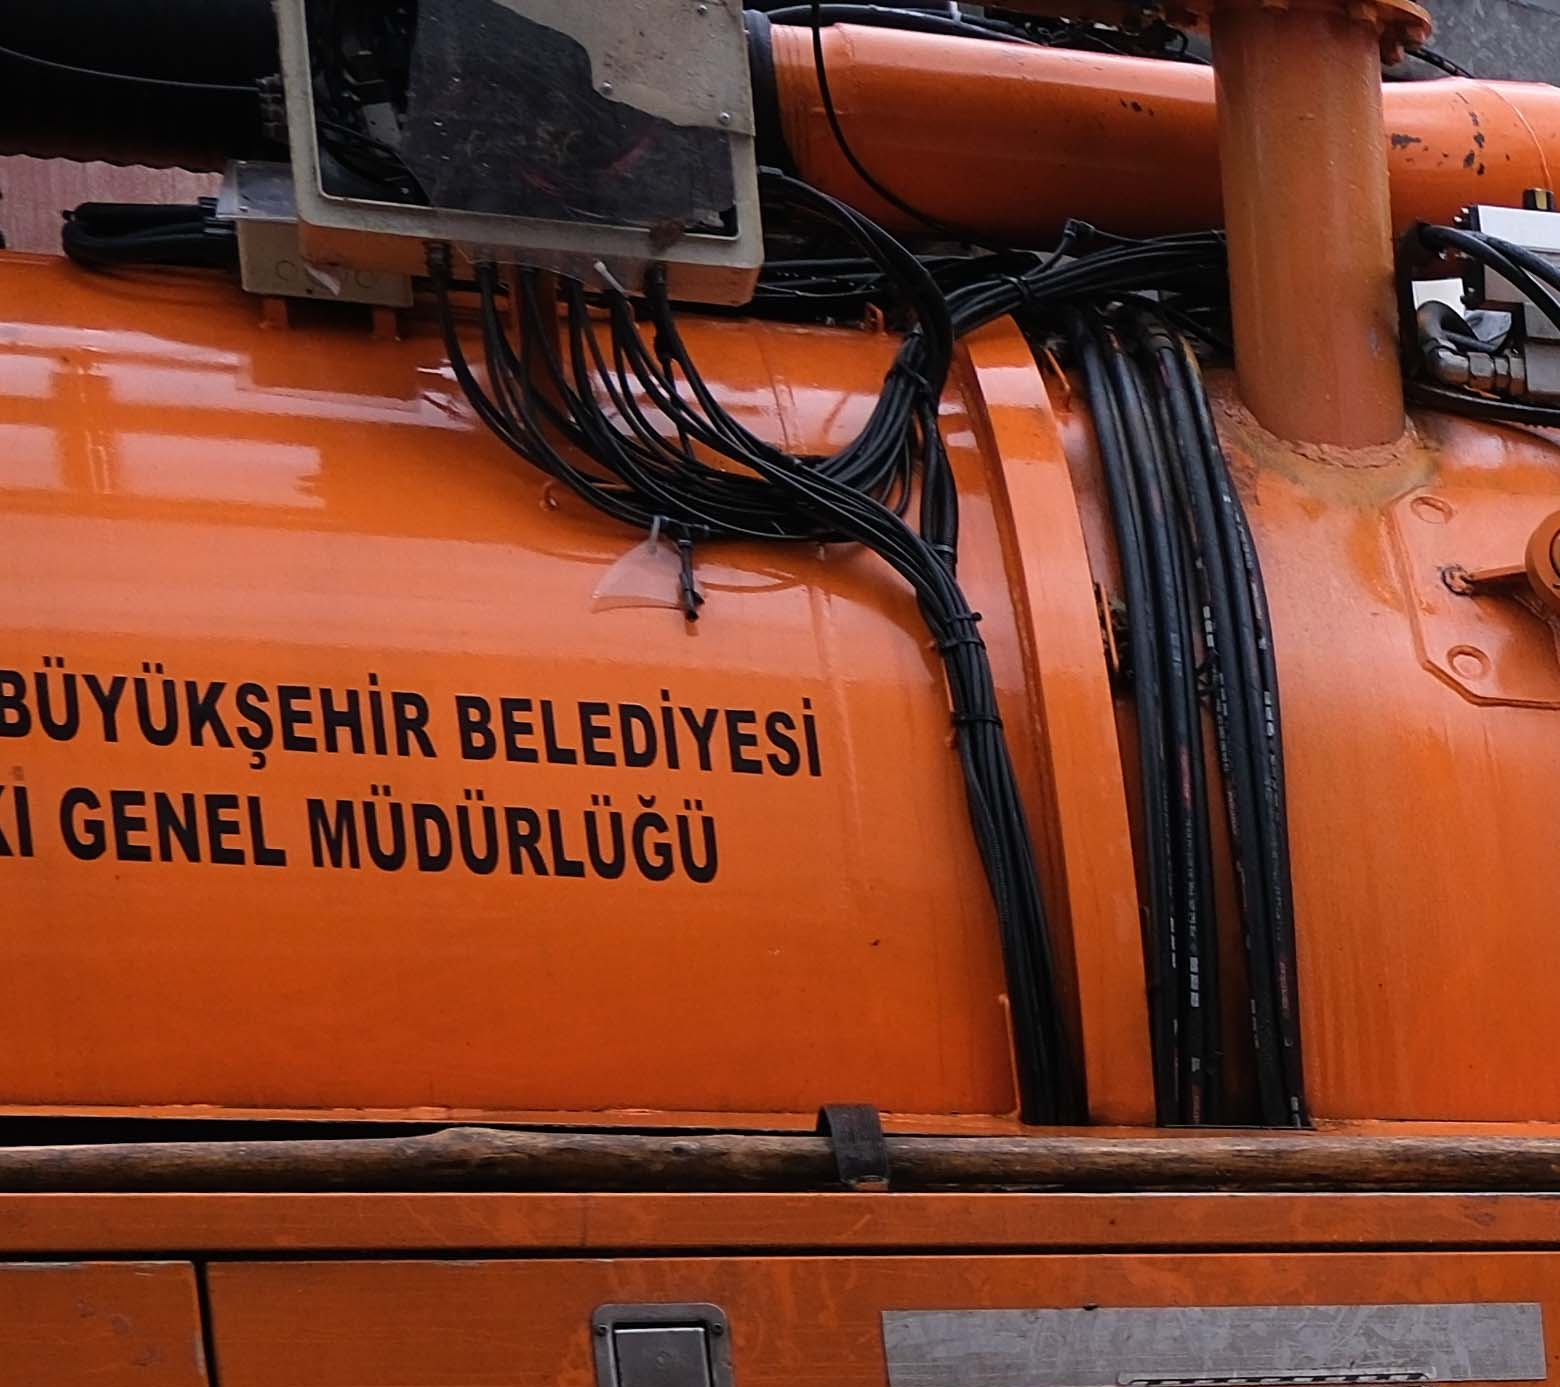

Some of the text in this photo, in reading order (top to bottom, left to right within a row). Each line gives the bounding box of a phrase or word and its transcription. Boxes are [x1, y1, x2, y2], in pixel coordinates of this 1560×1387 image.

[0, 656, 822, 777] BÜYÜKŞEHİR BELEDİYESİ
[60, 786, 286, 866] GENEL
[308, 785, 718, 884] MÜDÜRLÜĞÜ
